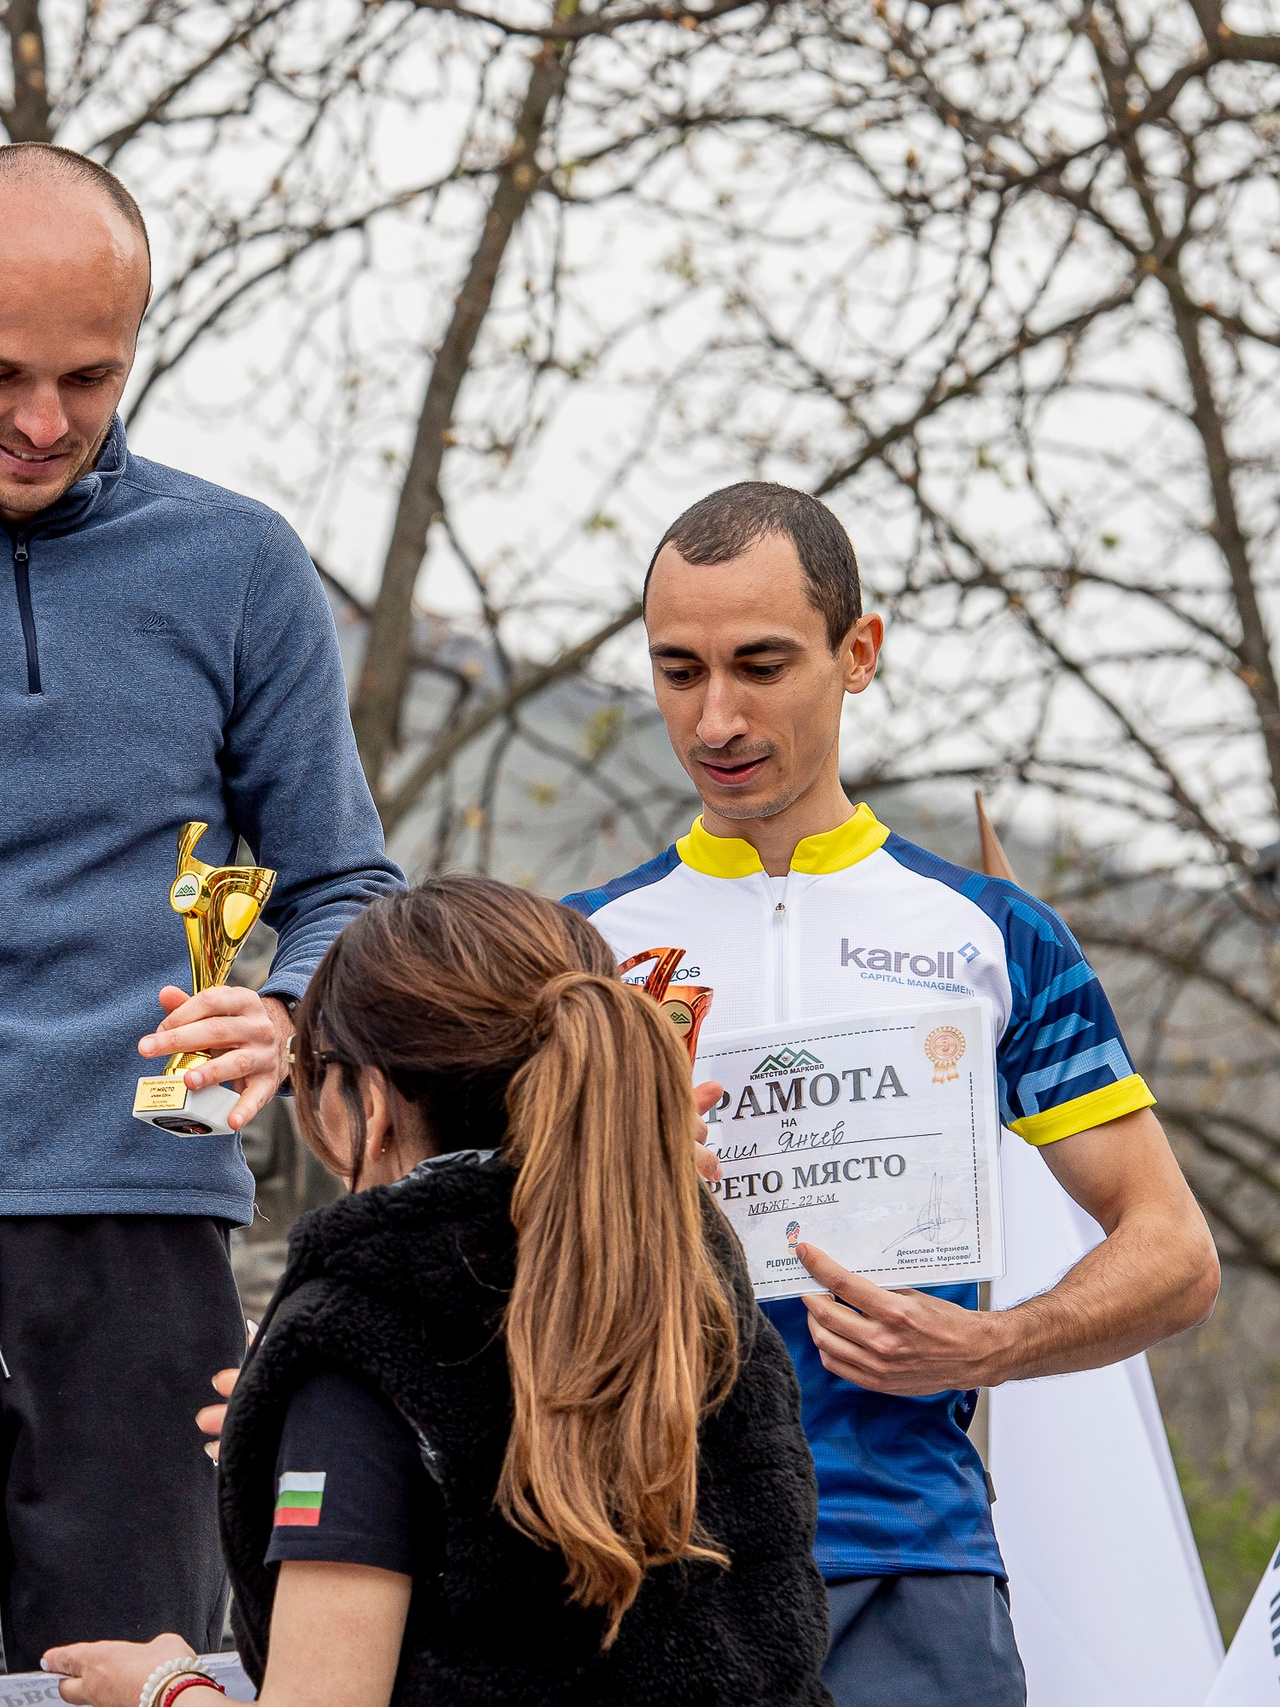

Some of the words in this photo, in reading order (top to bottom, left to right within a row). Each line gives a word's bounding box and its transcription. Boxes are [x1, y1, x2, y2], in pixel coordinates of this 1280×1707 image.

[840, 938, 954, 979] karoll
[860, 971, 904, 985] CAPITAL
[907, 978, 975, 997] MANAGEMENT
[750, 1069, 788, 1081] КМЕТСТВО
[789, 1063, 825, 1075] МАРКОВО
[705, 1065, 908, 1123] РАМОТА
[781, 1119, 798, 1128] НА
[792, 1154, 906, 1190] МЯСТО
[748, 1199, 789, 1215] МЪЖЕ
[799, 1195, 813, 1206] 22
[897, 1248, 935, 1257] Десислава
[936, 1245, 969, 1254] Терзиева
[897, 1257, 918, 1265] /Кмет
[937, 1253, 971, 1262] Марково/
[766, 1257, 799, 1268] PLOVDIV
